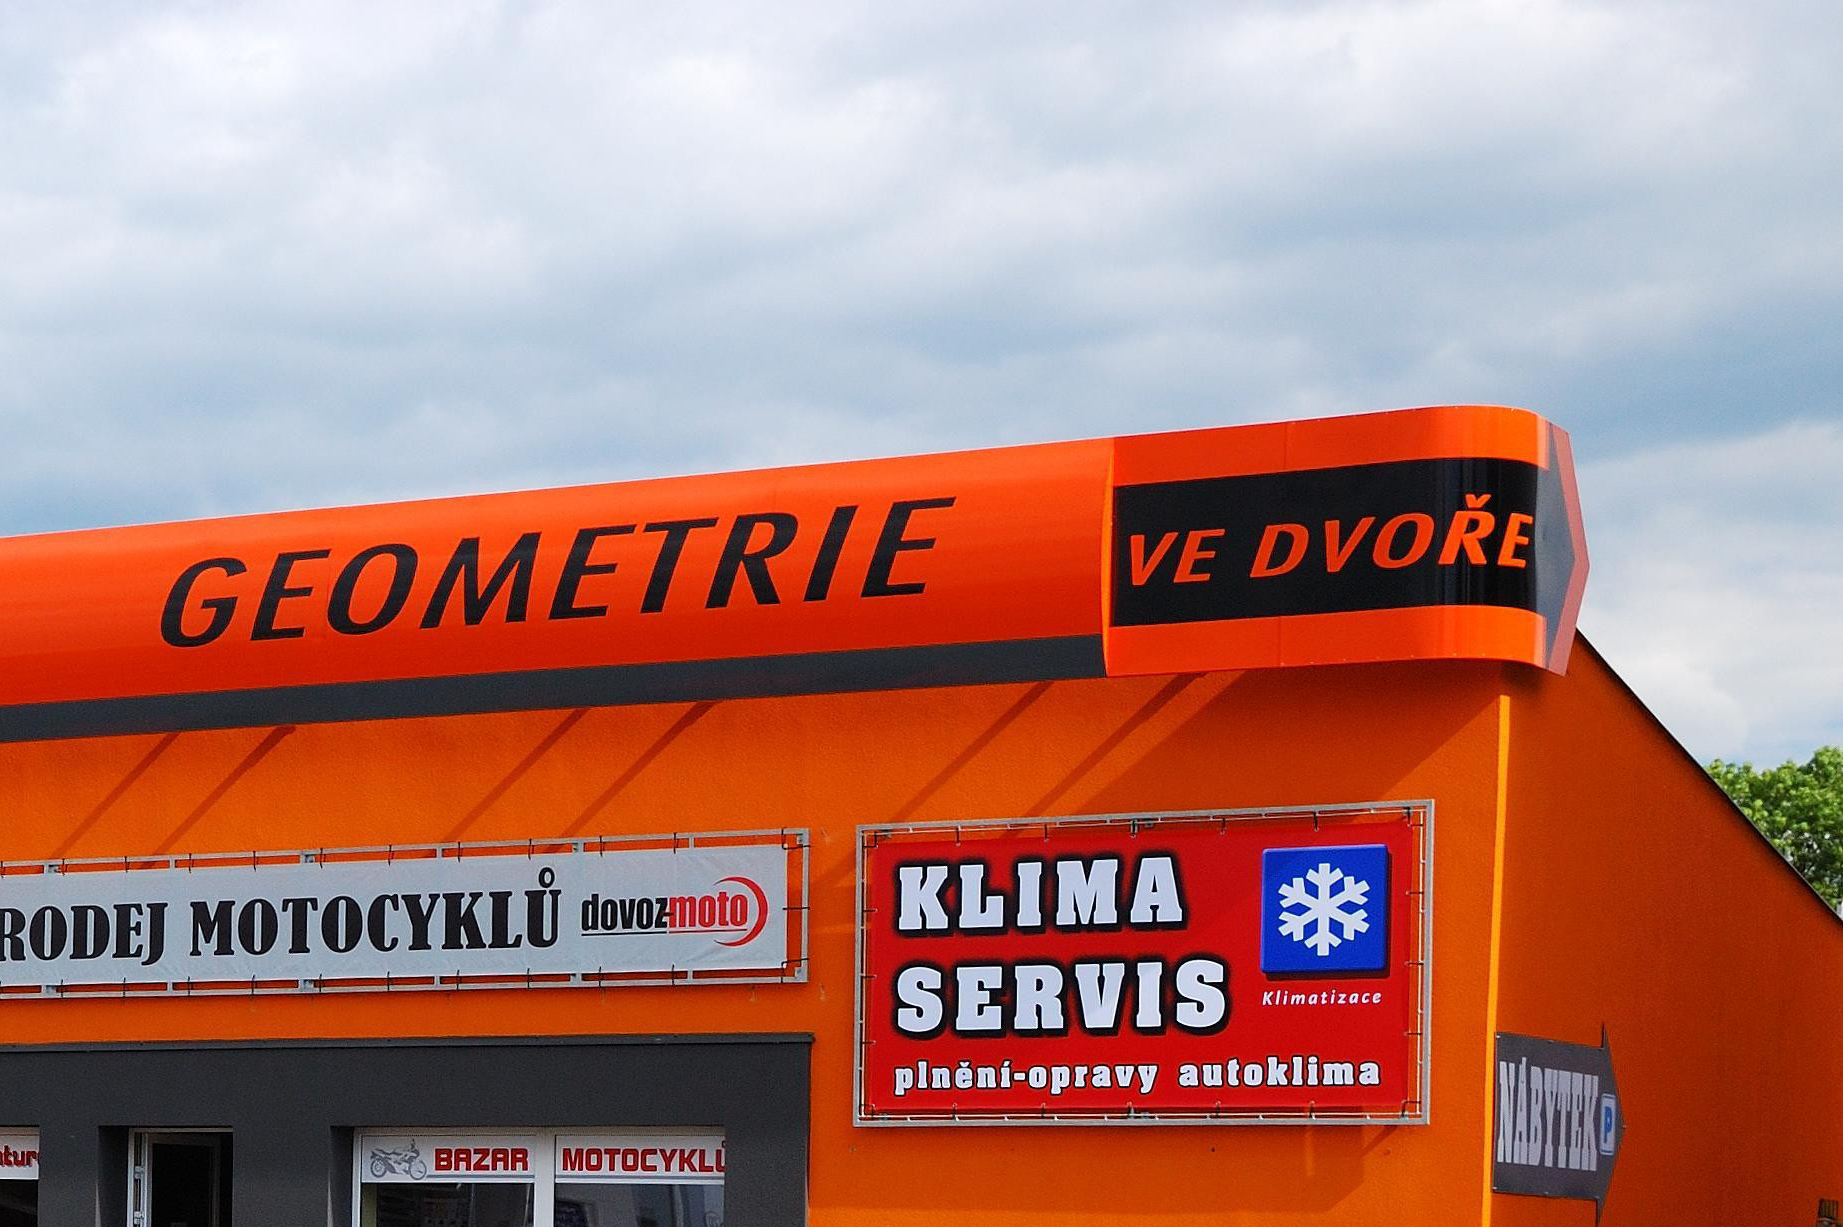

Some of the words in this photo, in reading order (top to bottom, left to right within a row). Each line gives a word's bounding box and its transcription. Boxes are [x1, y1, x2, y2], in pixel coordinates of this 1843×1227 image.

[161, 496, 954, 647] GEOMETRIE
[1130, 528, 1225, 586] VE
[1250, 494, 1533, 578] DVOŘE
[188, 867, 561, 957] MOTOCYKLŮ
[898, 856, 1183, 930] KLIMA
[897, 959, 1225, 1032] SERVIS
[1262, 988, 1382, 1006] Klimatizace
[894, 1060, 1158, 1095] plnění-opravy
[1178, 1056, 1380, 1086] autoklima
[1497, 1057, 1599, 1171] NÁBYTEK
[435, 1148, 529, 1171] BAZAR
